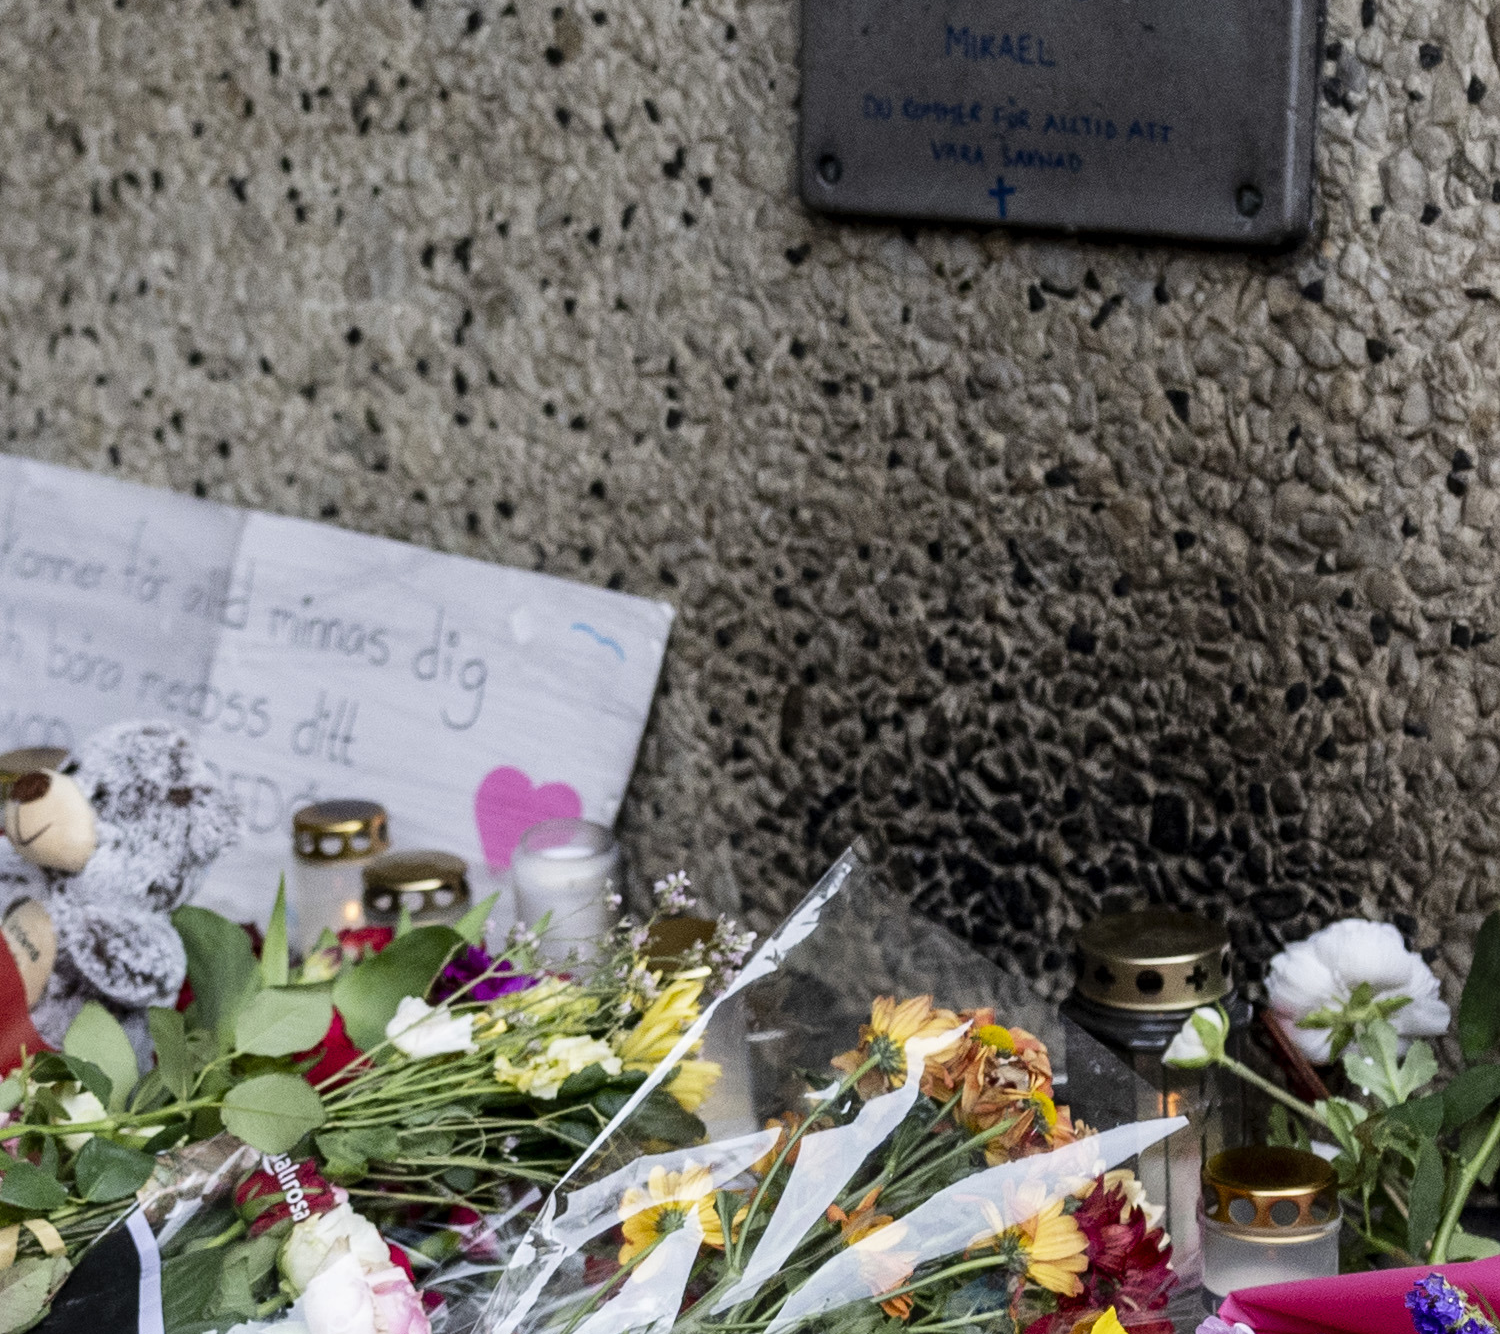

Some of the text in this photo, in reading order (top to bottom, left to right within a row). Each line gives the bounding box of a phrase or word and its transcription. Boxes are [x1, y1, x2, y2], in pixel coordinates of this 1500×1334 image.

[944, 23, 1056, 68] MIKAEL
[861, 92, 894, 120] DU
[1042, 114, 1119, 141] ALLTID
[1126, 119, 1174, 144] ATT
[930, 139, 985, 167] VARA
[410, 605, 490, 733] dig
[291, 689, 357, 767] ditt
